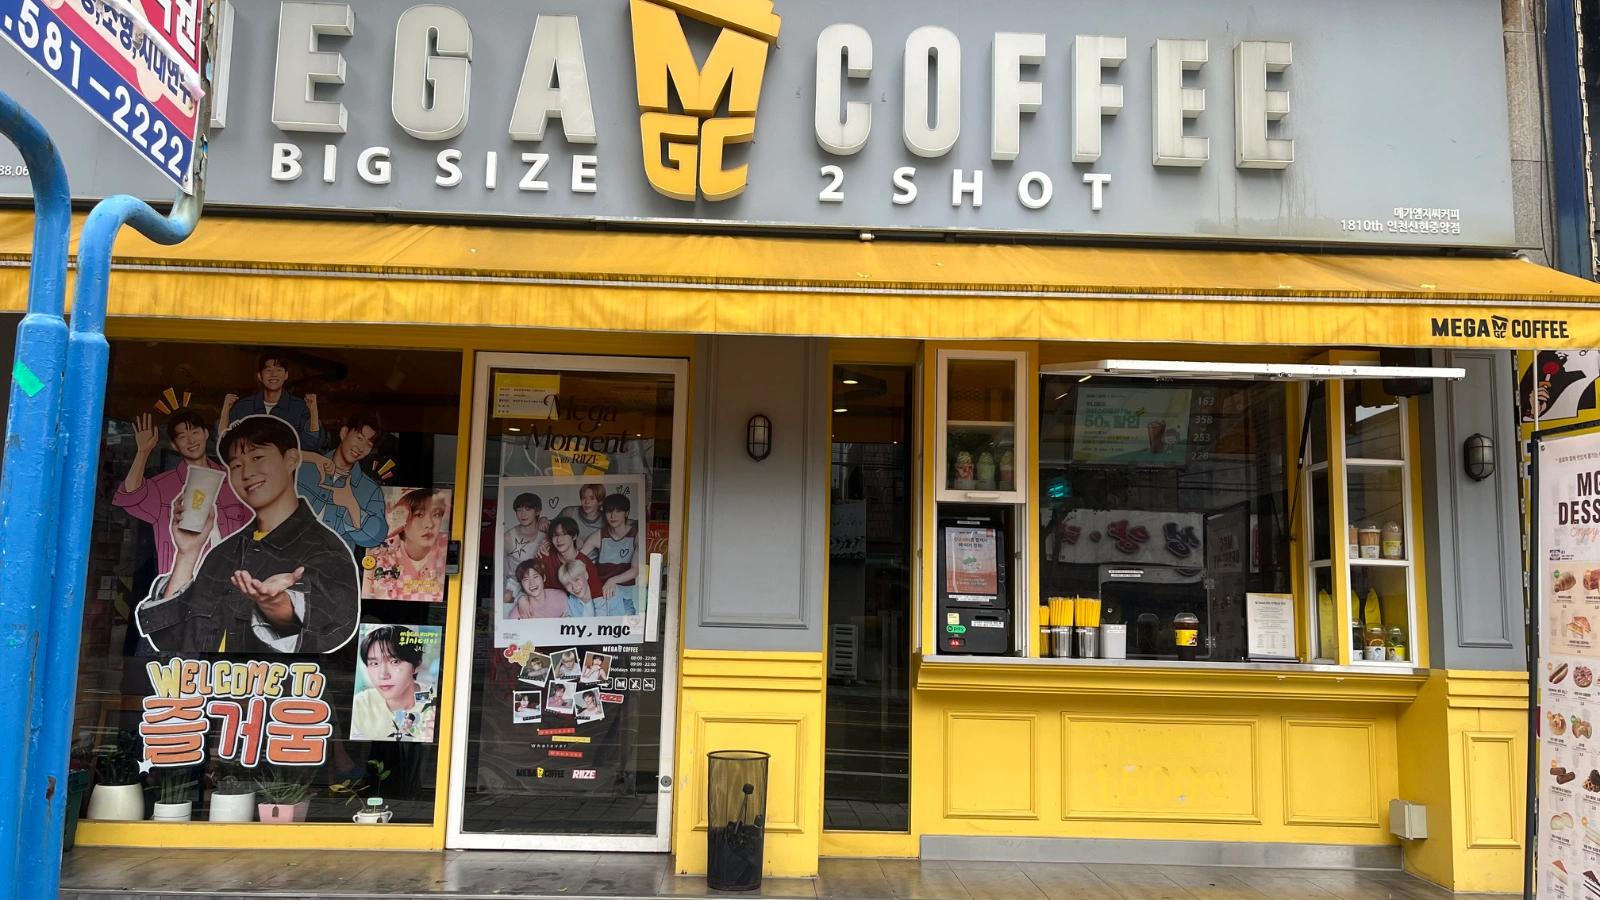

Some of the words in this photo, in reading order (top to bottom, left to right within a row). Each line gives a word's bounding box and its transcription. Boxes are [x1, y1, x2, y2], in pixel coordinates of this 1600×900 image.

[209, 0, 597, 144] EGA
[814, 22, 1295, 170] COFFEE
[271, 143, 392, 184] BIG
[435, 149, 598, 193] SIZE
[819, 165, 844, 202] 2
[892, 166, 1112, 211] SHOT
[1340, 220, 1383, 232] 1810th
[1394, 207, 1460, 220] 메가엠지씨커피
[1431, 318, 1490, 338] MEGA
[1512, 319, 1569, 339] COFFEE
[543, 393, 618, 433] Mega
[1195, 415, 1213, 424] 358
[525, 424, 632, 454] Moment
[1193, 433, 1211, 442] 253
[597, 624, 631, 638] mgc
[147, 659, 286, 698] WELCOME
[138, 697, 332, 767] 즐거움
[572, 770, 596, 779] RIIZE
